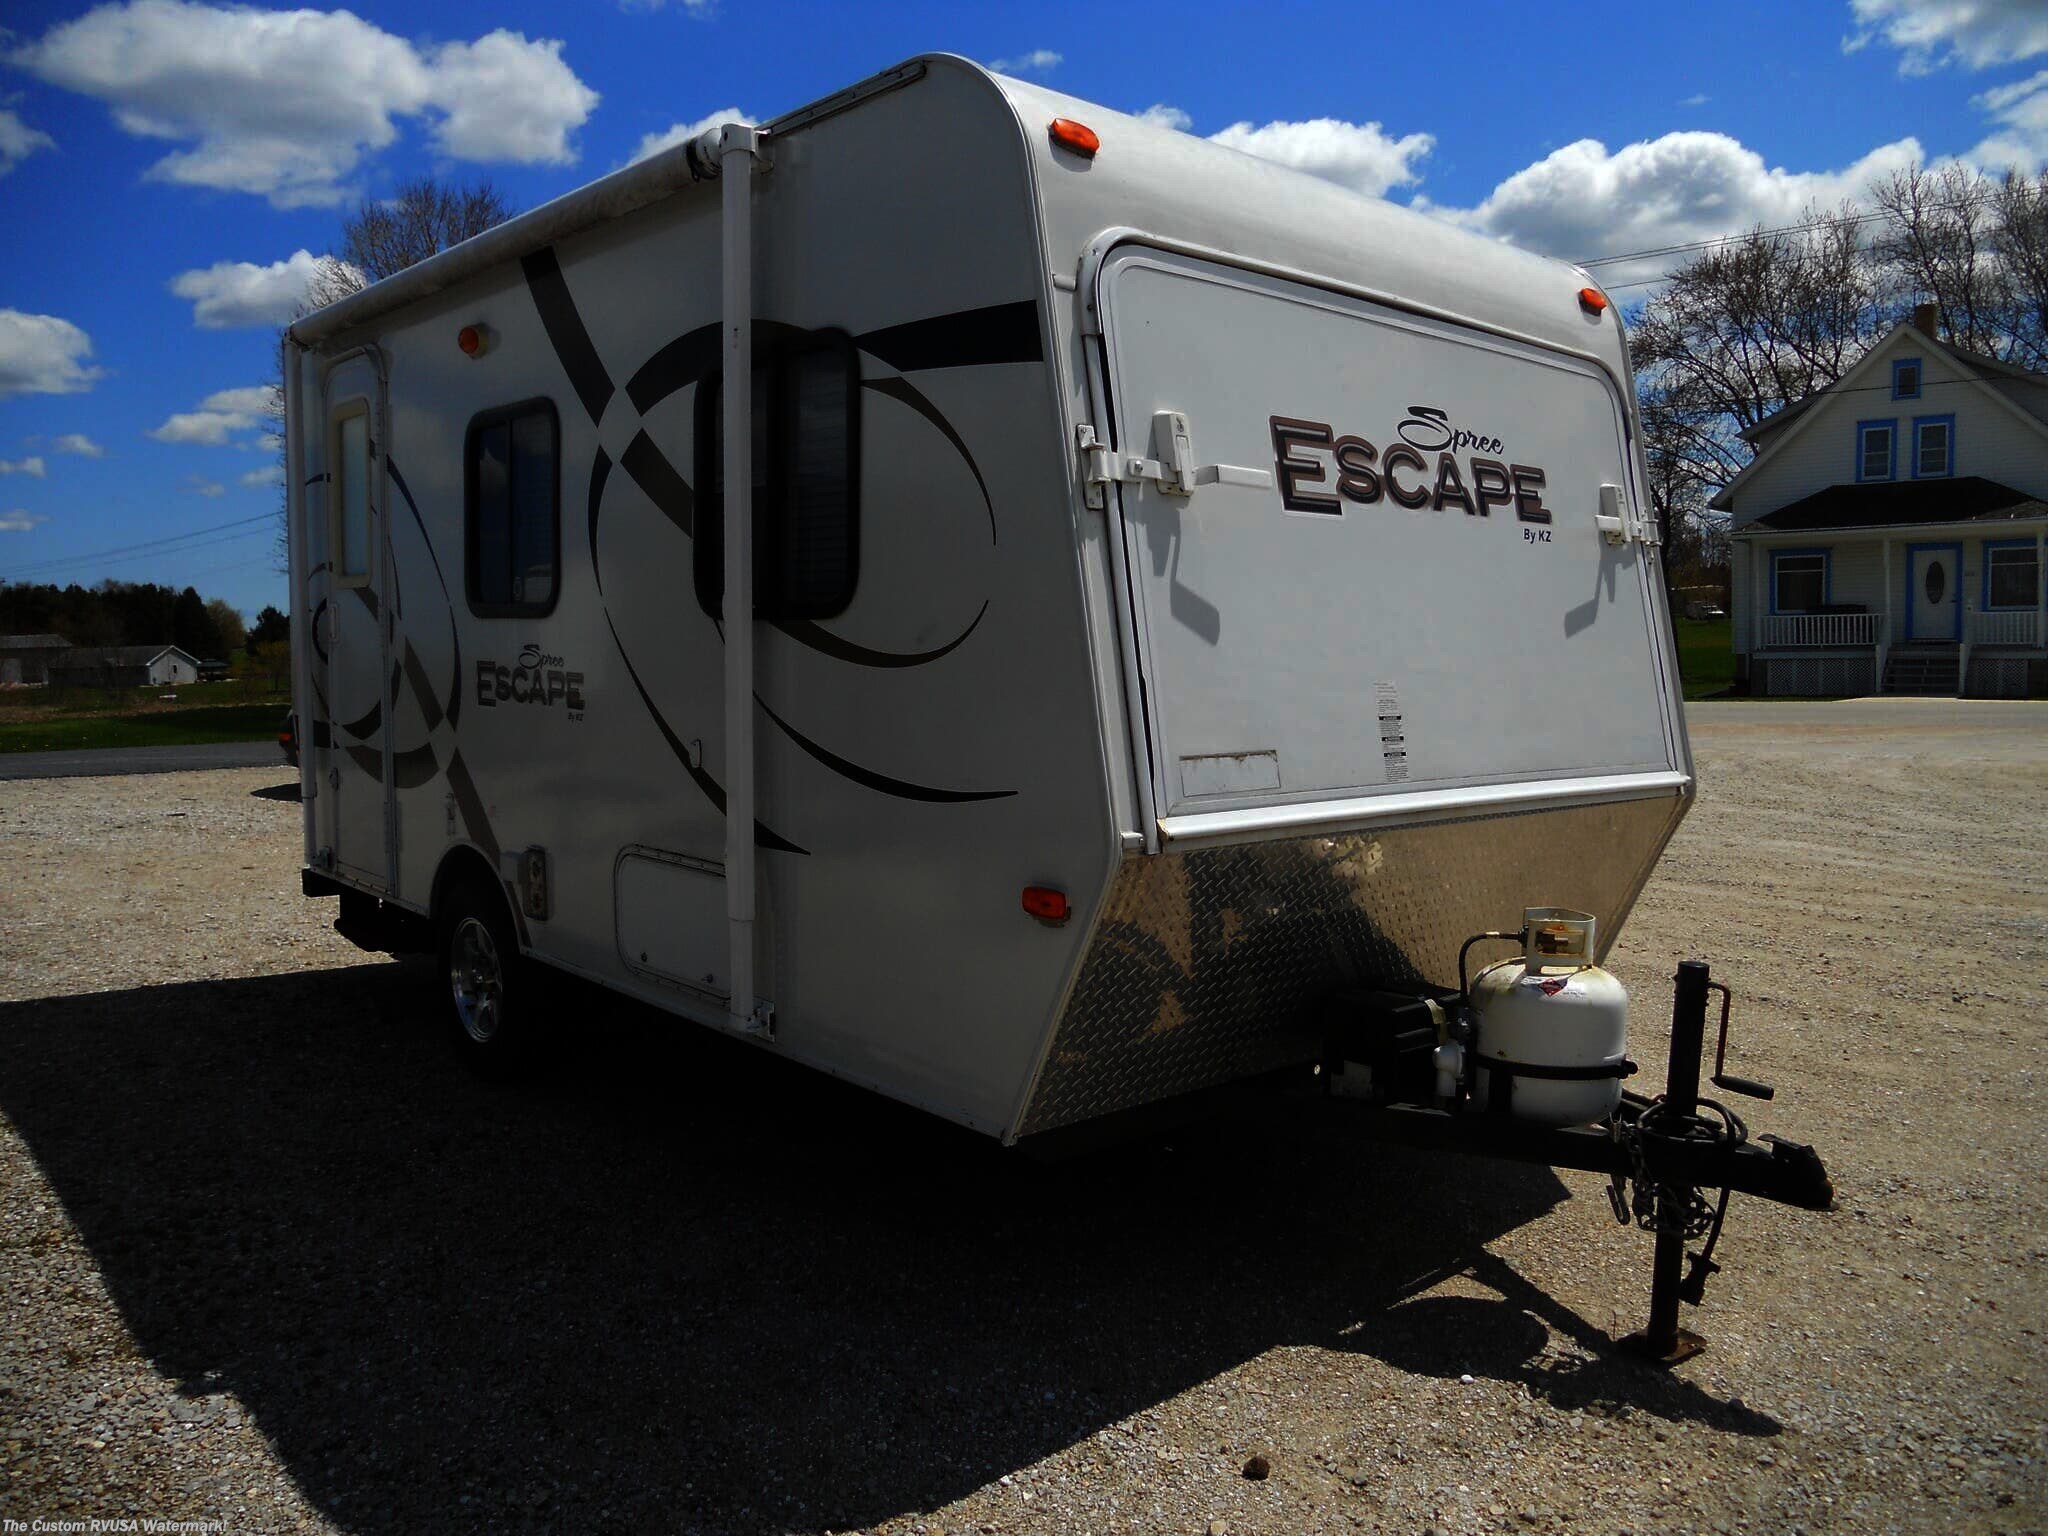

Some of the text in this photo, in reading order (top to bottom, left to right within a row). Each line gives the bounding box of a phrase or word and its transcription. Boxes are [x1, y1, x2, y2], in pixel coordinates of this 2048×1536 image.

[1397, 405, 1504, 455] Spree
[1269, 415, 1552, 524] ESCAPE
[1523, 528, 1552, 544] By KZ
[518, 644, 565, 669] Spree
[476, 660, 586, 710] ESCAPE
